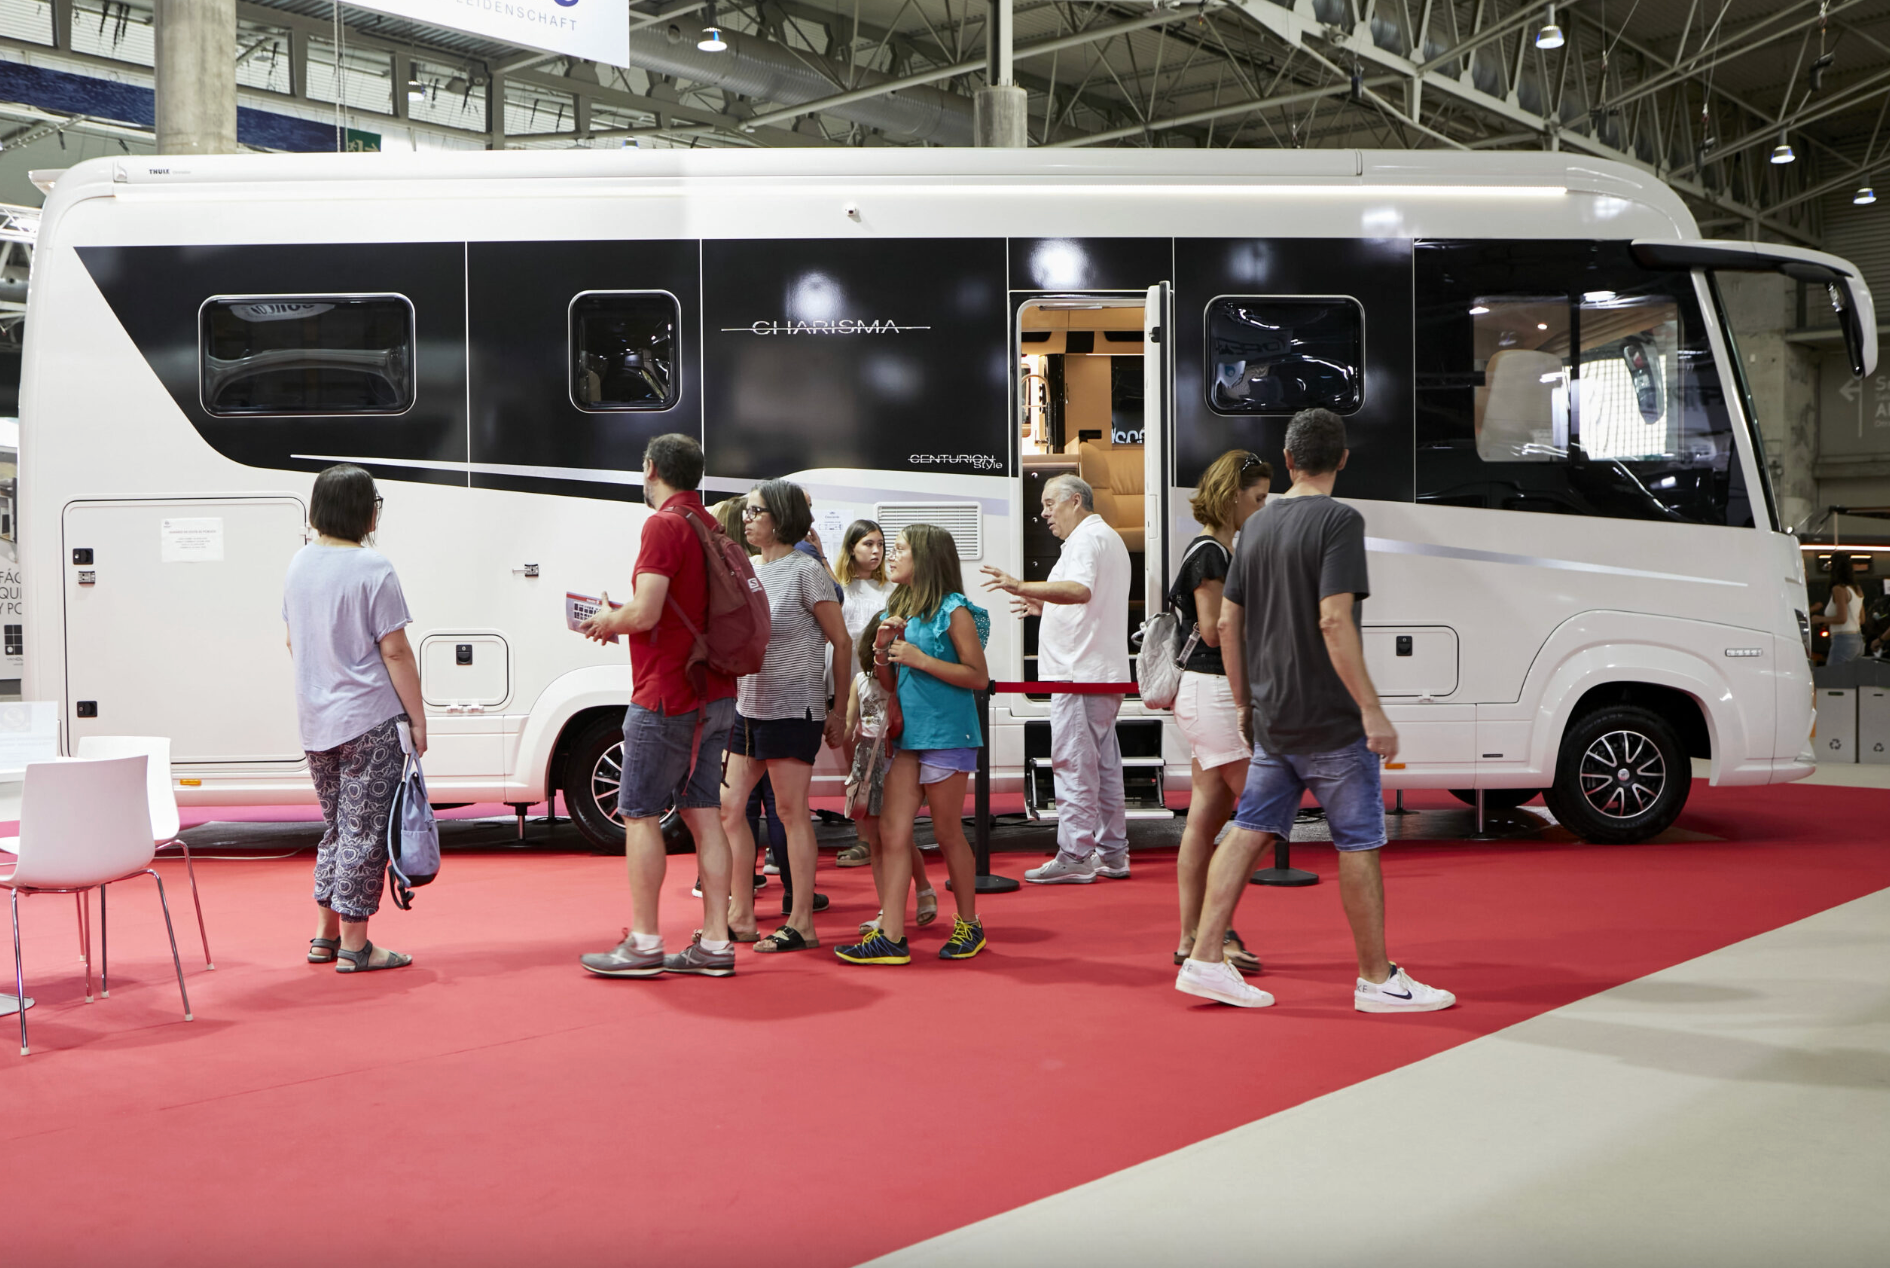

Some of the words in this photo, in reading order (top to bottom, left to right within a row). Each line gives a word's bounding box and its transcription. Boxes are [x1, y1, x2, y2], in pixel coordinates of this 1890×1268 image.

[752, 319, 900, 336] CHARISMA
[1875, 375, 1890, 391] S
[1874, 402, 1890, 418] A
[909, 454, 995, 464] CENTURION
[973, 461, 1003, 470] Style
